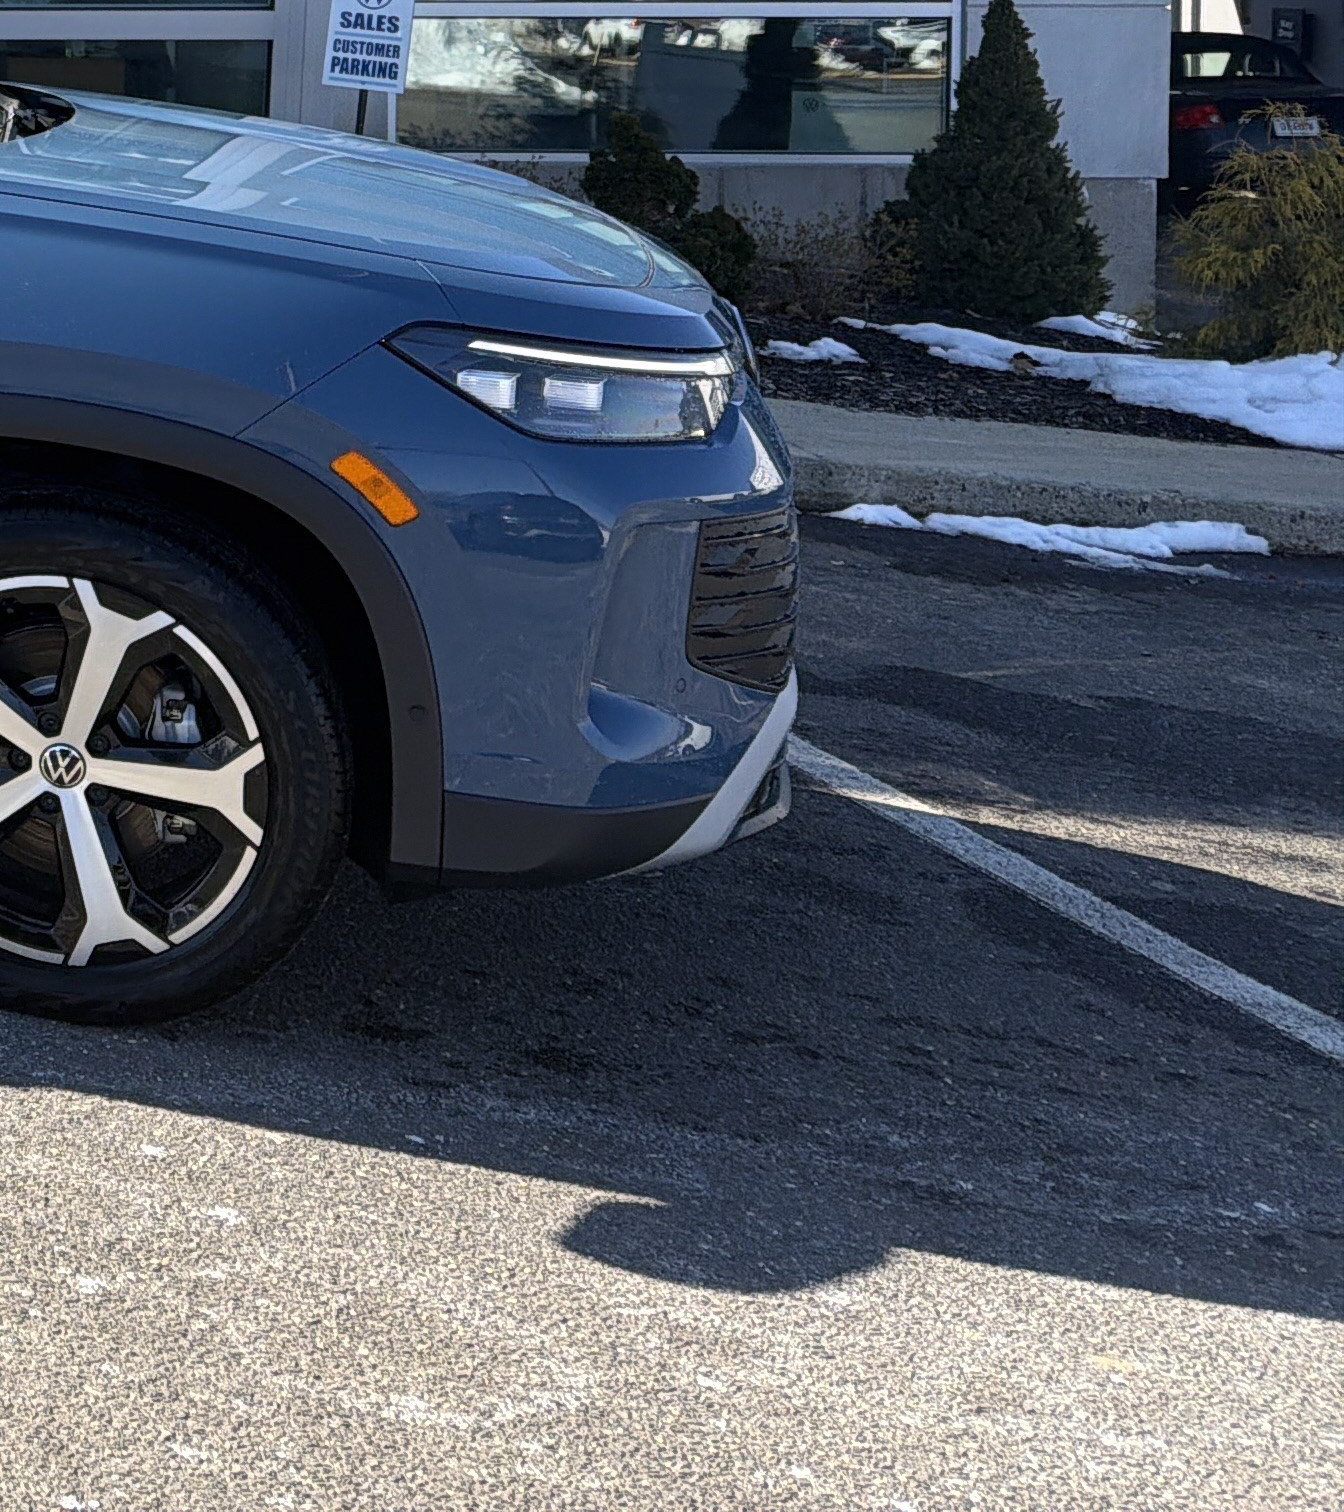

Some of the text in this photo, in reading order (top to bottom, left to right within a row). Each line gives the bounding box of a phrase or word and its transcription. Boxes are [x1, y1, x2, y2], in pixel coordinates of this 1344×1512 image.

[338, 10, 400, 34] SALES
[332, 38, 401, 59] CUSTOMER
[330, 56, 399, 80] PARKING
